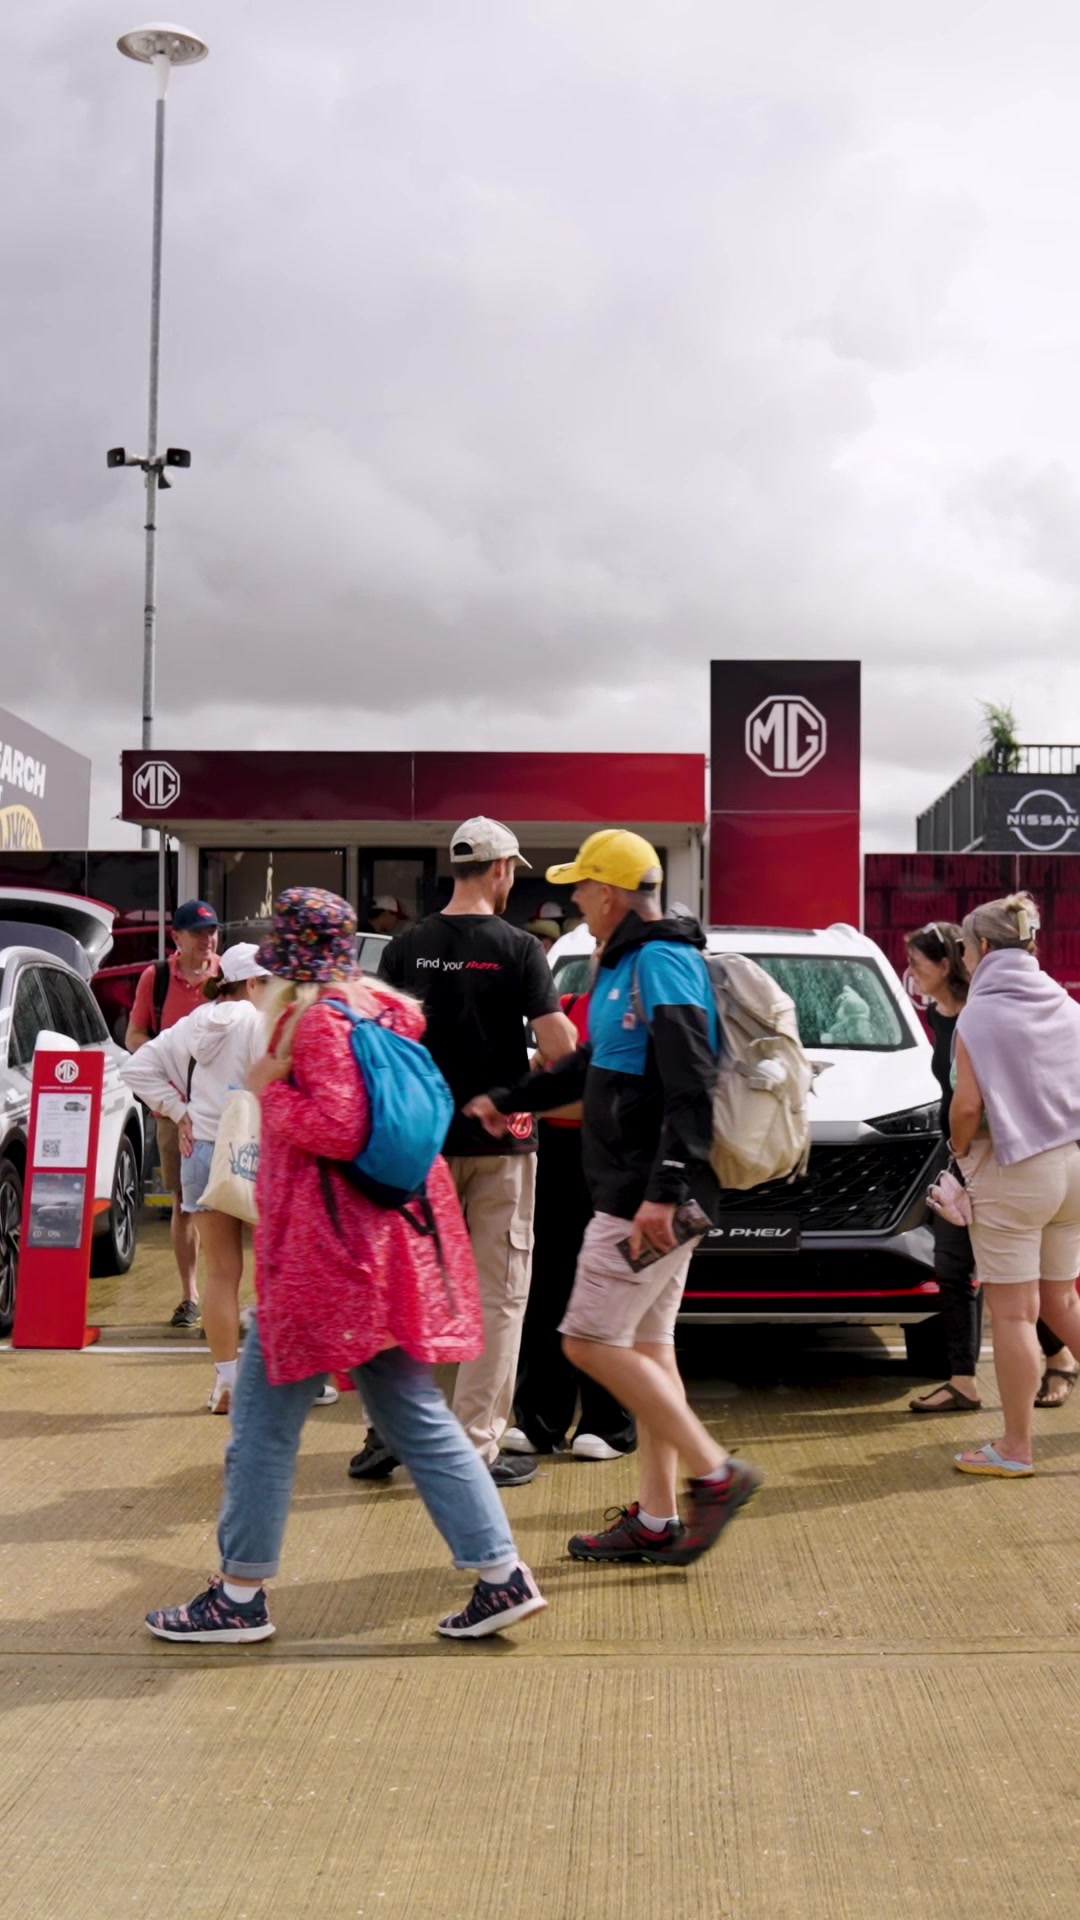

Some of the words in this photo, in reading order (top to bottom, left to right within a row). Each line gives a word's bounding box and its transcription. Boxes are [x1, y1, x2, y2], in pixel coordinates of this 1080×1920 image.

[752, 702, 820, 770] MG
[0, 741, 46, 799] ARCH
[136, 764, 177, 806] MG
[1007, 814, 1079, 827] NISSAN
[416, 958, 440, 969] Find
[443, 961, 465, 971] your
[56, 1060, 78, 1083] MG
[729, 1228, 792, 1238] PHEV
